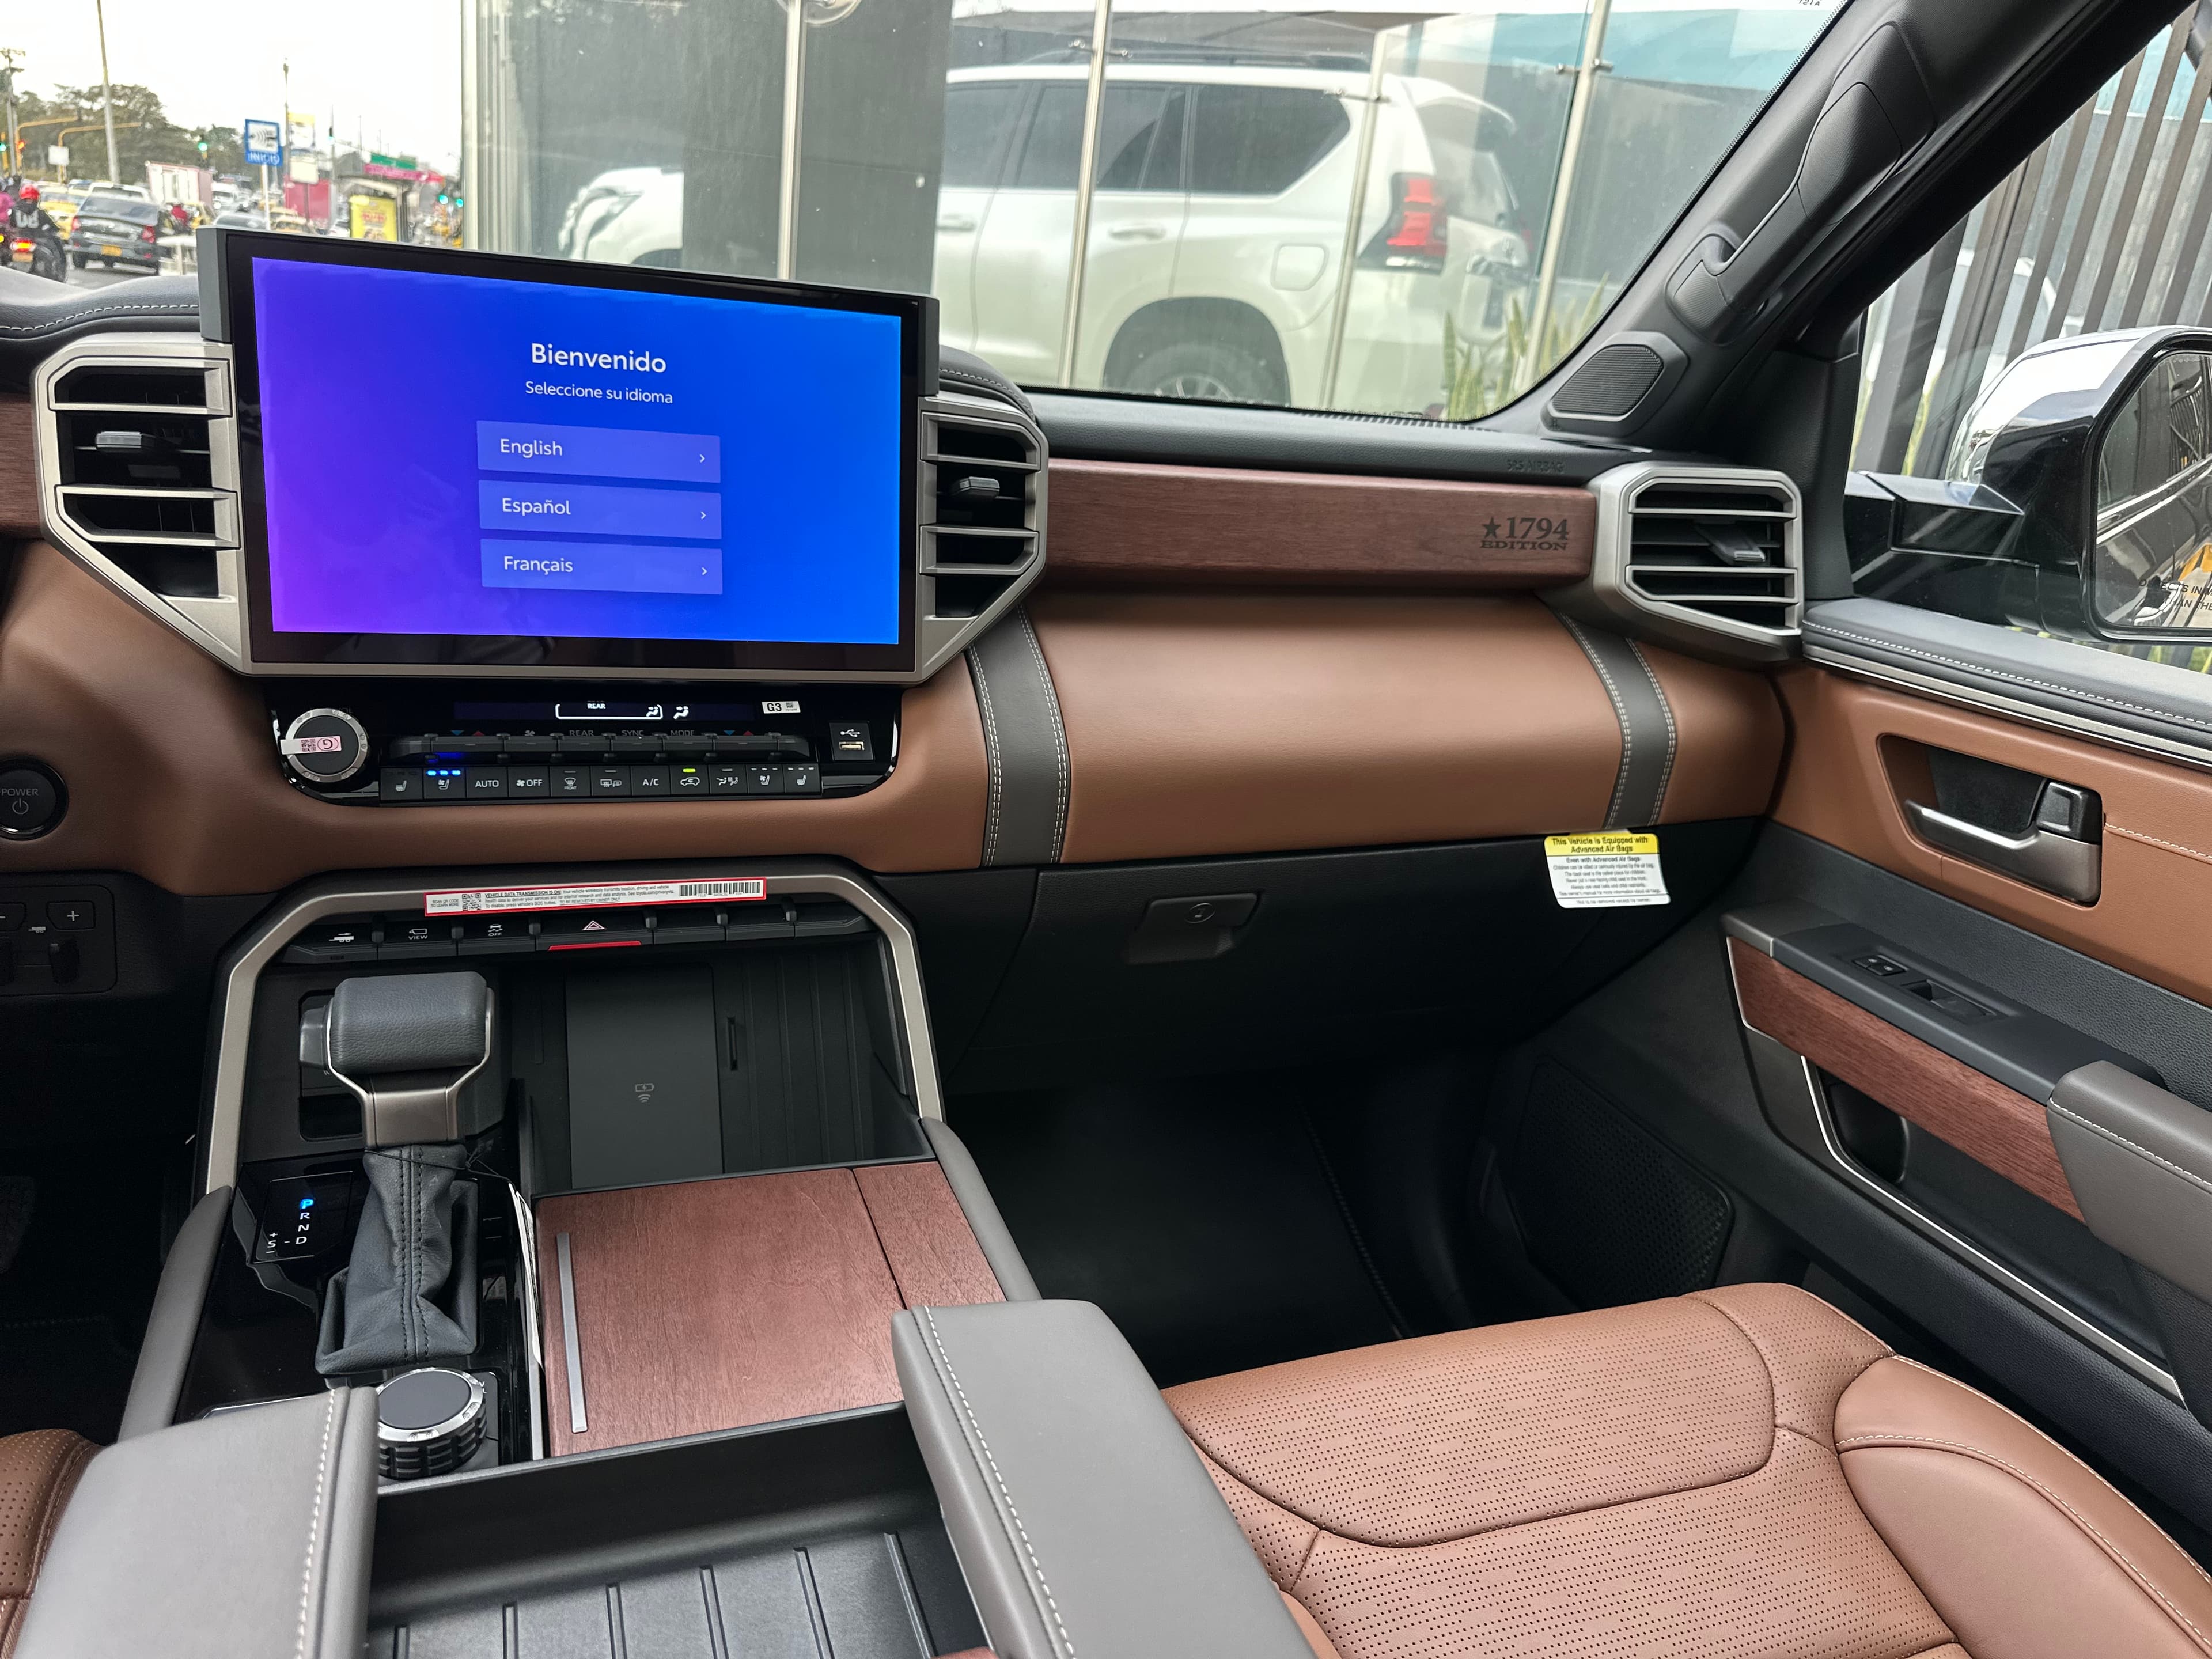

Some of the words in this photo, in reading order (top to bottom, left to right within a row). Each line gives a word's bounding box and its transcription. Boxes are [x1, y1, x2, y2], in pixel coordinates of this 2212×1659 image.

[531, 342, 666, 373] Bienvenido
[525, 381, 603, 399] Seleccione
[606, 389, 623, 401] su
[626, 388, 673, 403] idioma
[500, 438, 563, 459] English
[502, 497, 571, 517] Español
[1506, 517, 1569, 540] 1794
[1479, 540, 1568, 551] EDITION
[503, 556, 574, 575] Français
[2191, 585, 2203, 594] IN
[767, 703, 782, 711] G3
[323, 739, 333, 749] G
[642, 778, 659, 786] A/C
[1, 788, 39, 796] POWER
[1602, 836, 1633, 845] Equipped
[1616, 845, 1633, 854] Bags
[301, 1199, 314, 1209] P
[300, 1212, 310, 1220] R
[296, 1236, 307, 1244] D
